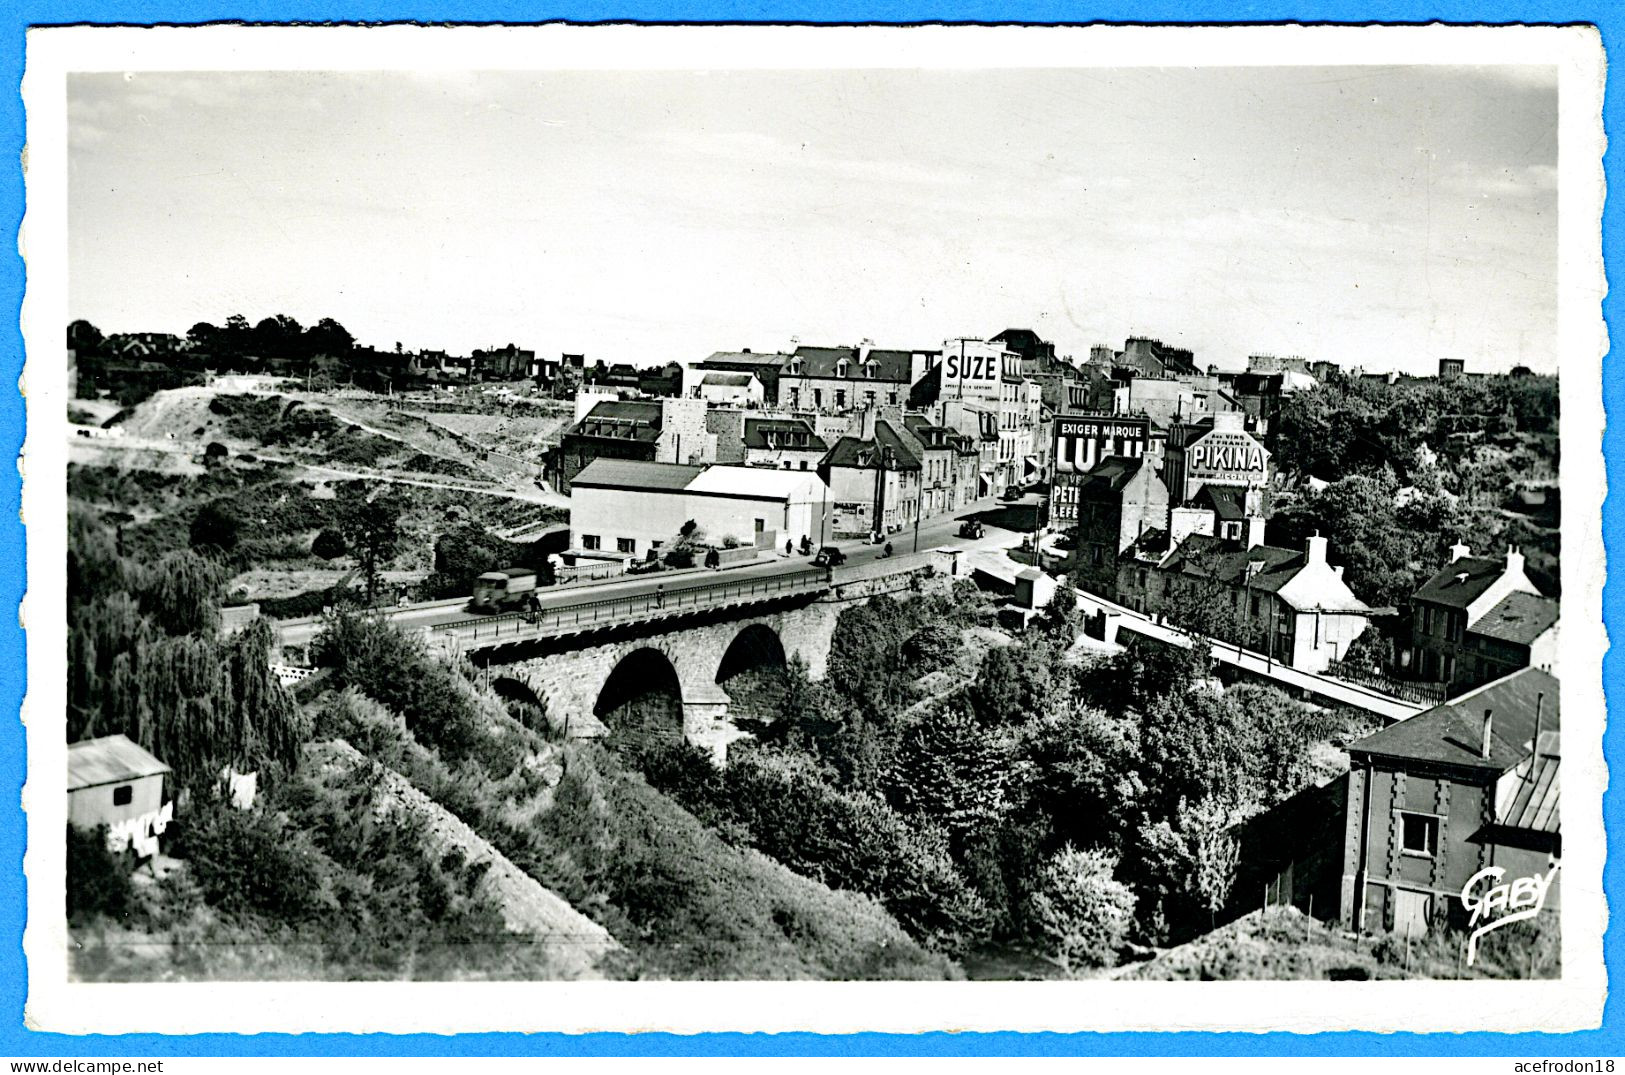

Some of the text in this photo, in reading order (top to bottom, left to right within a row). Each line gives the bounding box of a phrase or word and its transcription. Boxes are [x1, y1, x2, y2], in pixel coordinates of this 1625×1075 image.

[947, 355, 996, 380] SUZE
[1062, 424, 1142, 438] EXIGER MARQUE
[1192, 446, 1263, 472] PIKINA
